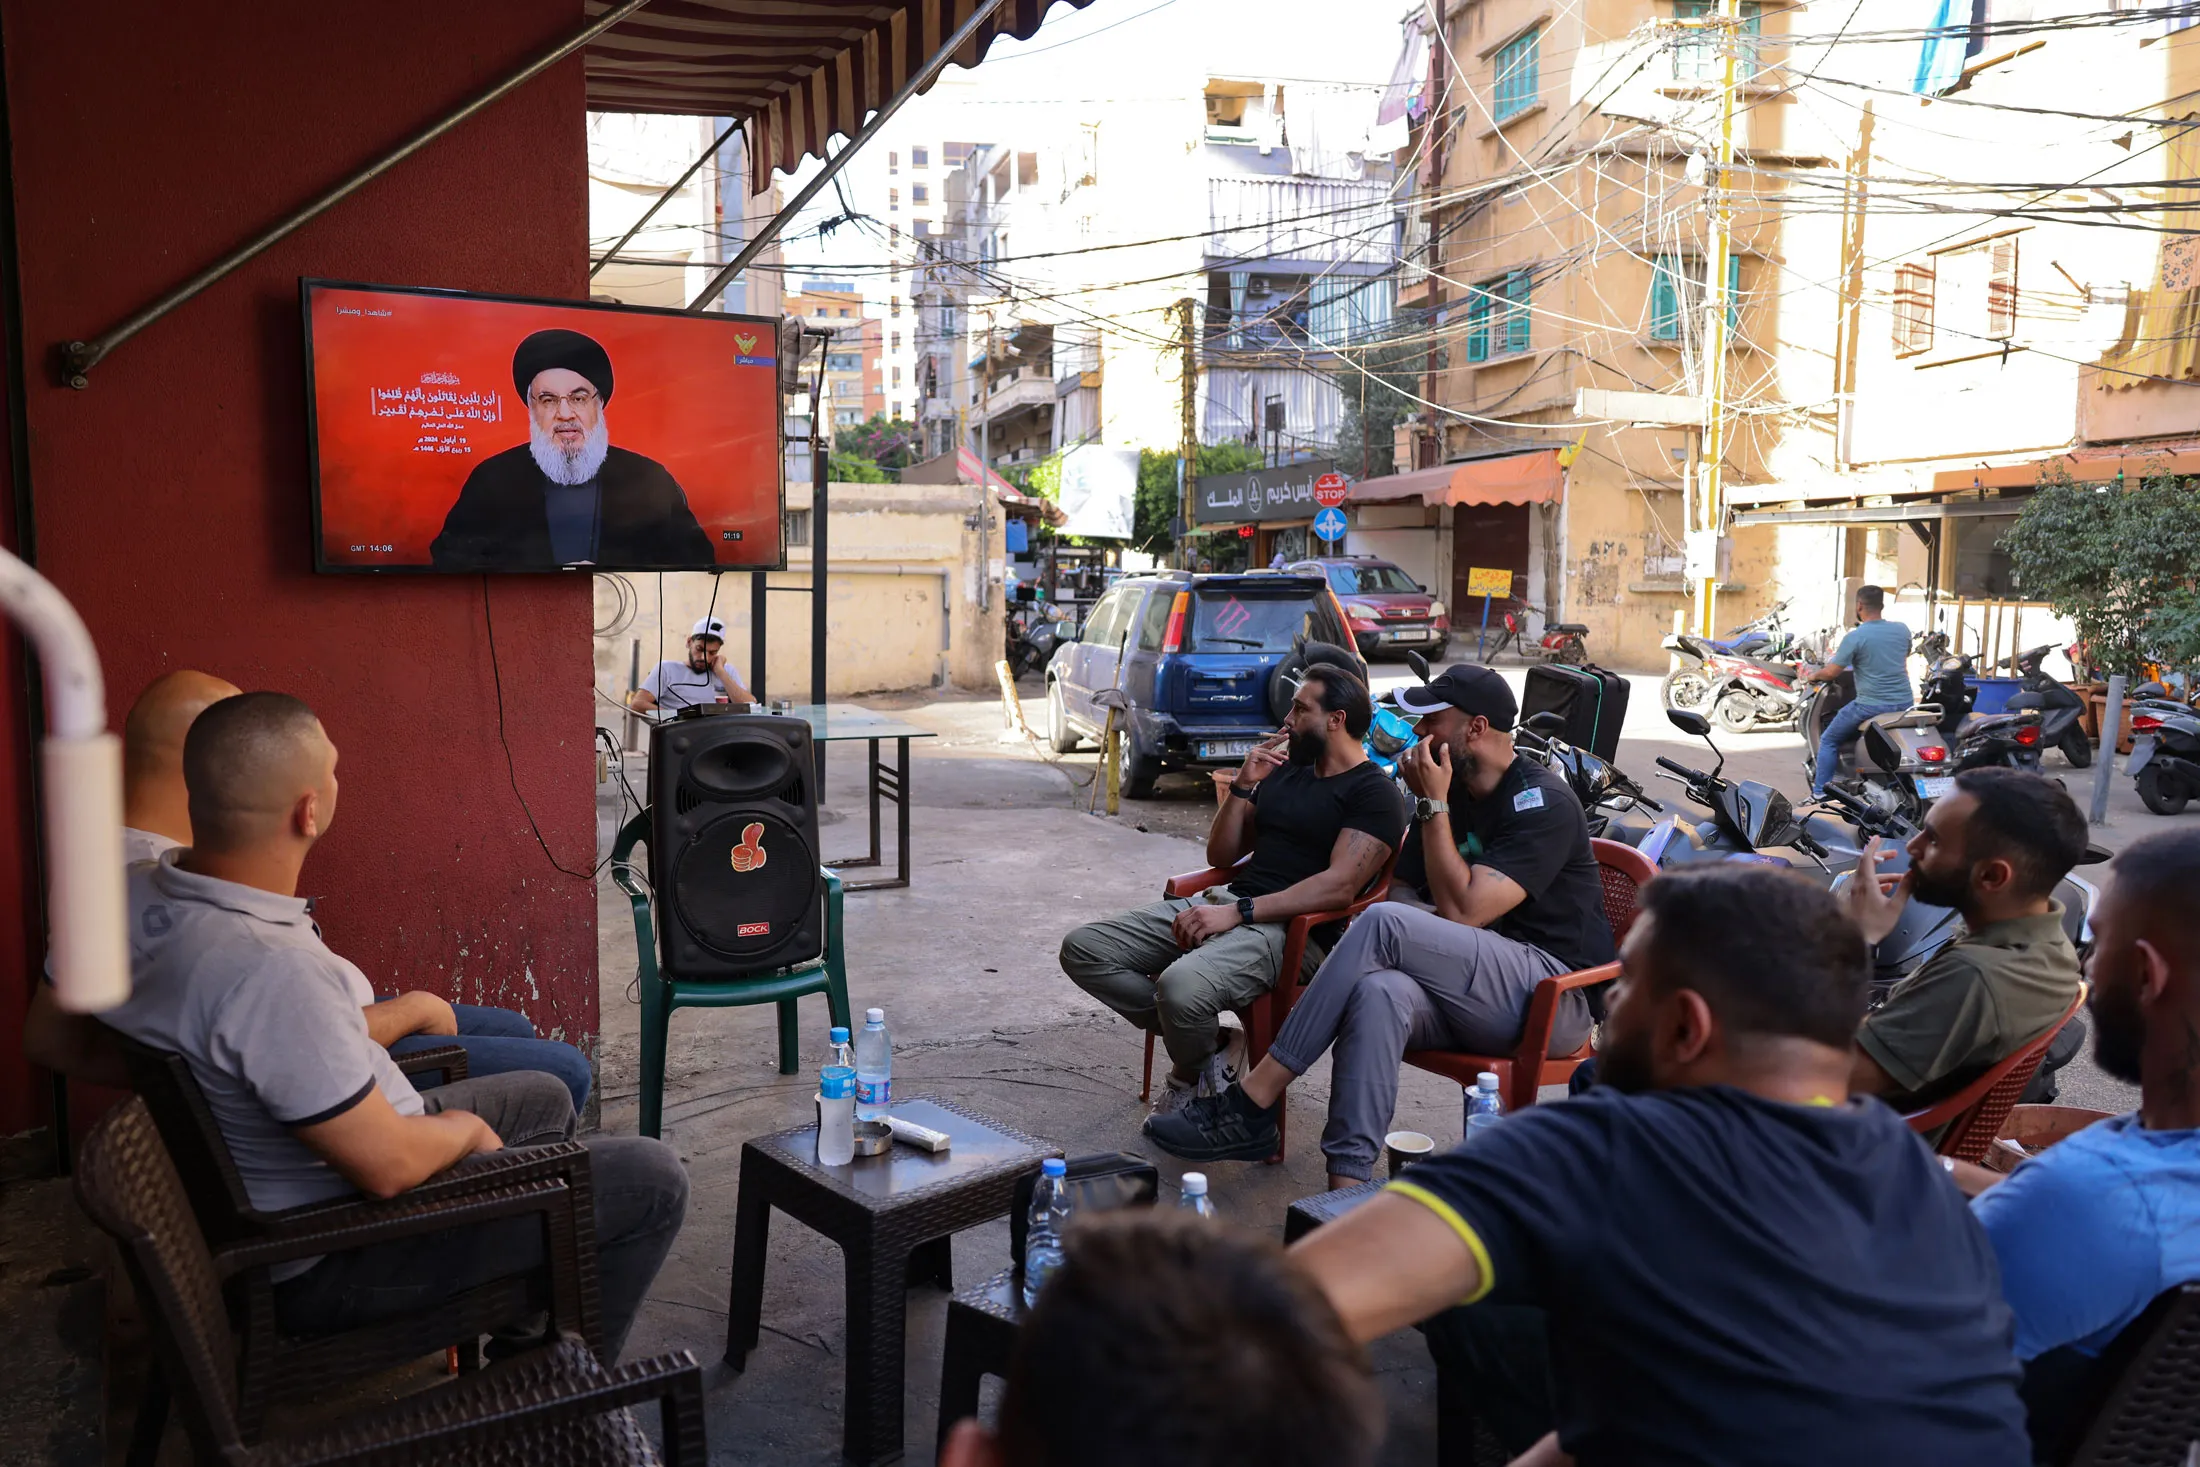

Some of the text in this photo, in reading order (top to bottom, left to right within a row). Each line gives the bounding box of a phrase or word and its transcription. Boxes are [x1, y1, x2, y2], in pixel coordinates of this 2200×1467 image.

[1318, 476, 1343, 488] قف
[1206, 486, 1244, 508] الملك
[1266, 481, 1291, 505] كريم
[1316, 489, 1345, 500] STOP
[350, 544, 393, 552] GMT 14:06
[1208, 741, 1216, 755] B
[739, 925, 768, 934] BOCK
